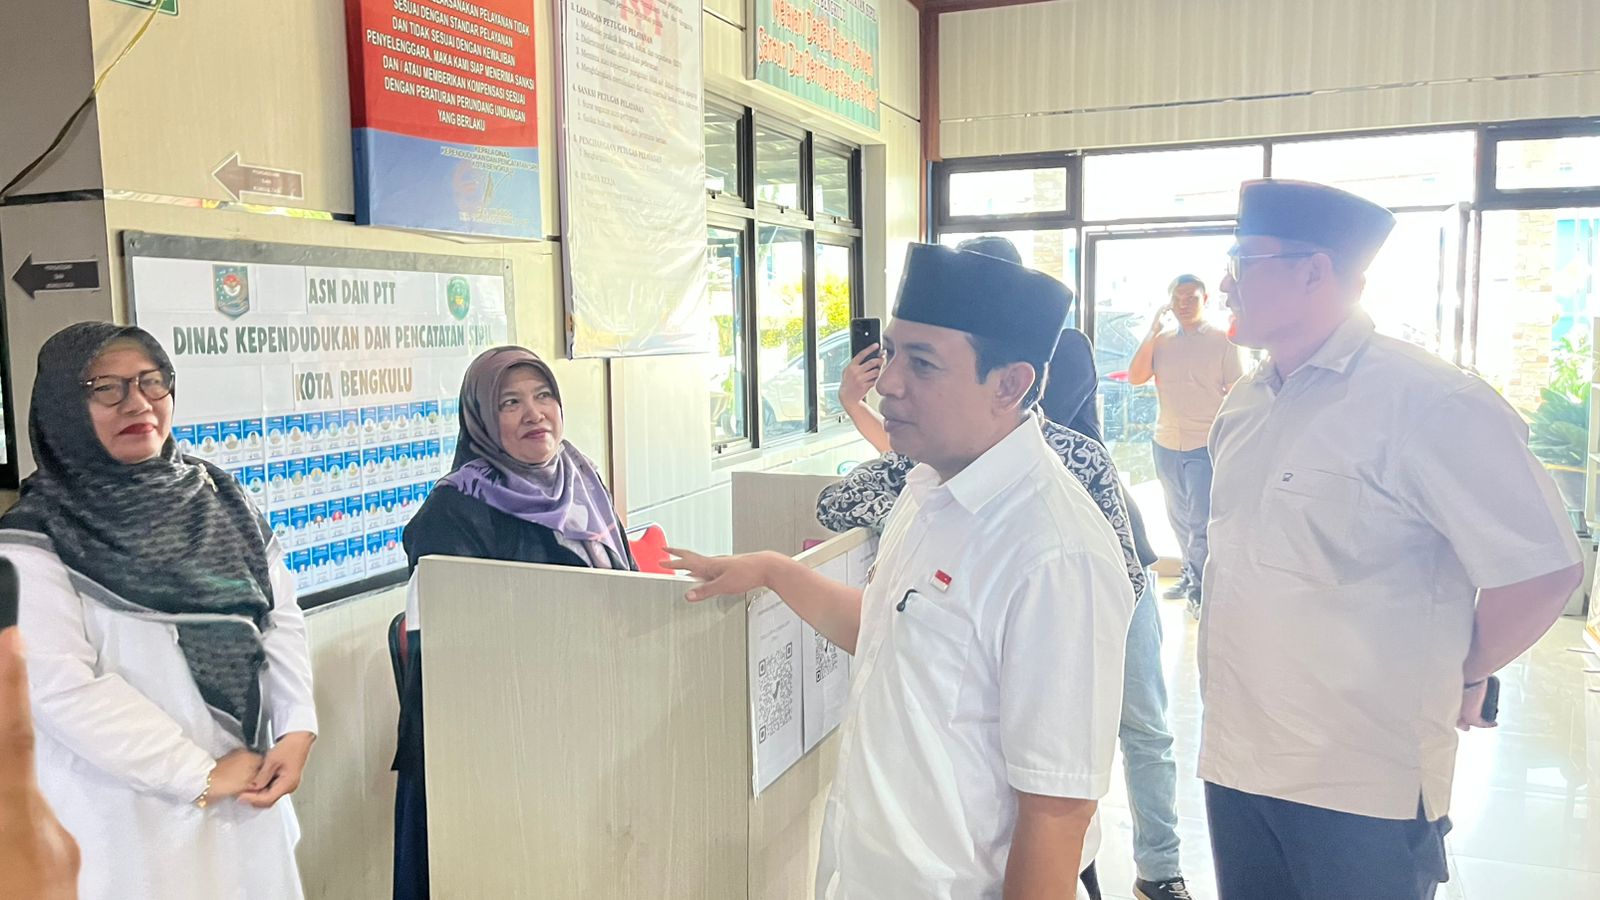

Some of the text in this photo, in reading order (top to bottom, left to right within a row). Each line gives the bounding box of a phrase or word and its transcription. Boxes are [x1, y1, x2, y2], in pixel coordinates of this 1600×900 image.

[393, 0, 513, 48] SESUAI DENGAN STANDAR PELAYANAN
[480, 7, 513, 30] PELAYANAN
[514, 20, 530, 36] TIDAK
[603, 17, 628, 35] PETUGAS
[392, 16, 516, 66] DAN TIDAK SESUAI DENGAN KEWAJIBAN
[367, 29, 535, 90] PENYELENGGARA, MAKA KAMI SIAP MENERIMA SANKSI
[383, 55, 399, 71] DAN
[404, 61, 422, 77] ATAU
[423, 66, 466, 89] MEMBERIKAN
[467, 79, 505, 99] KOMPENSASI
[505, 89, 526, 105] SESUAI
[384, 76, 526, 123] DENGAN PERATURAN PERUNDANG UNDANGAN
[438, 109, 486, 132] YANG BERLAKU
[308, 278, 396, 305] ASN DAN PTT
[173, 324, 494, 355] DINAS KEPENDUDUKAN DAN PENCATATAN SIPIL
[294, 367, 413, 401] KOTA BENGKULU
